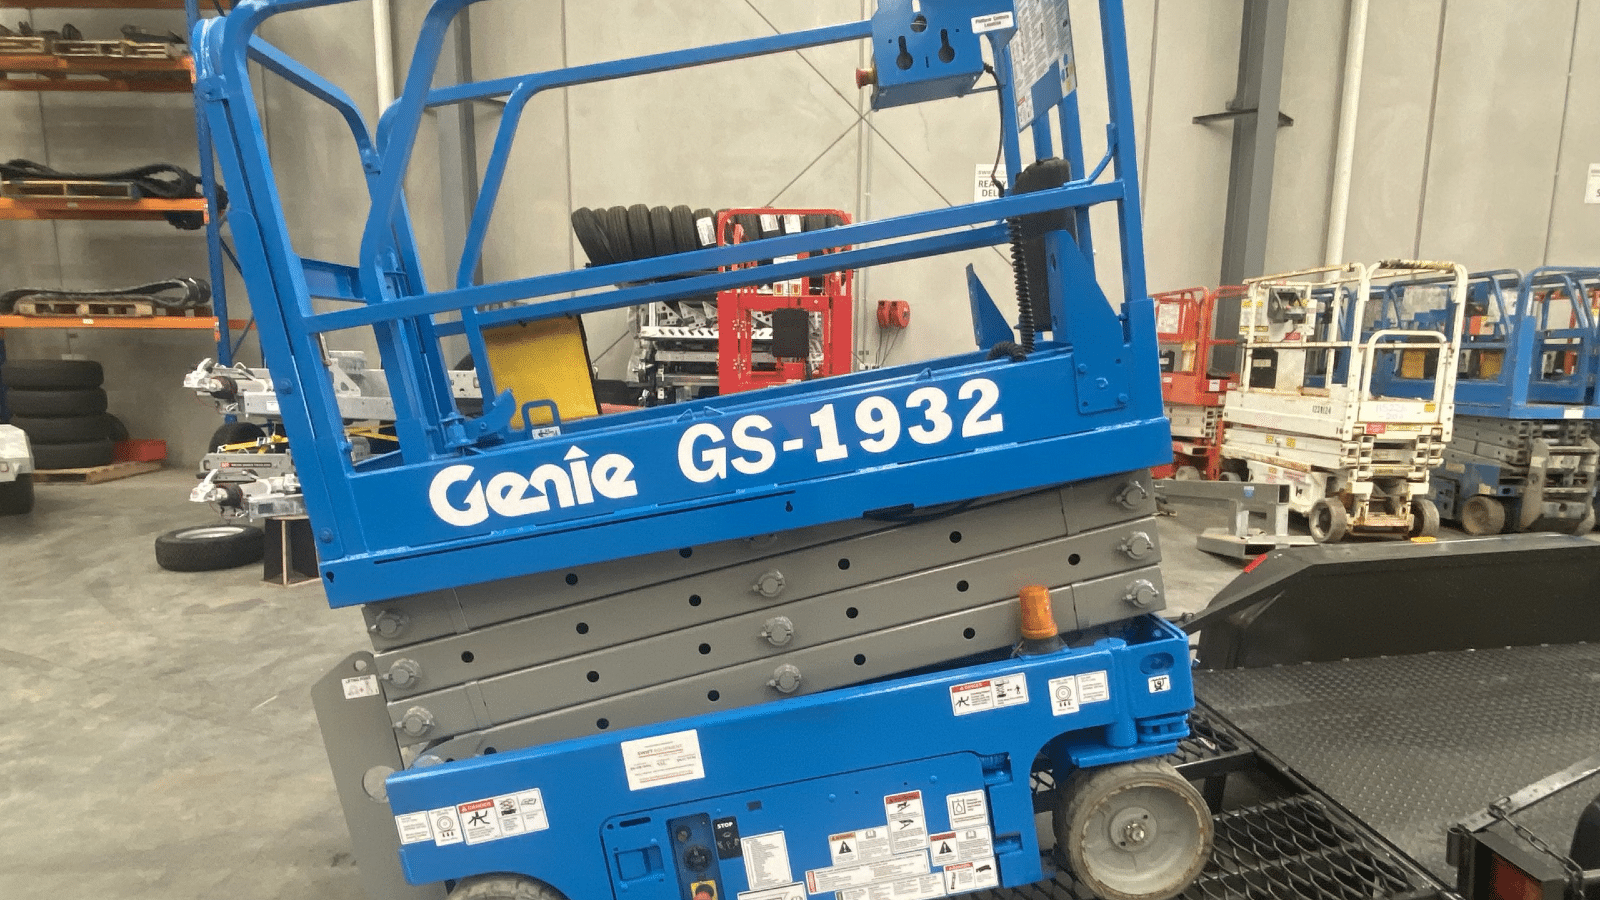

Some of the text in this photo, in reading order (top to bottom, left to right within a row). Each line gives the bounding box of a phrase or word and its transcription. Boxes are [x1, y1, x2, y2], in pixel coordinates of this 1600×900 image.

[978, 179, 1007, 188] REAY
[677, 378, 1004, 483] GS-1932
[429, 444, 638, 527] Genie
[716, 821, 734, 830] STOP
